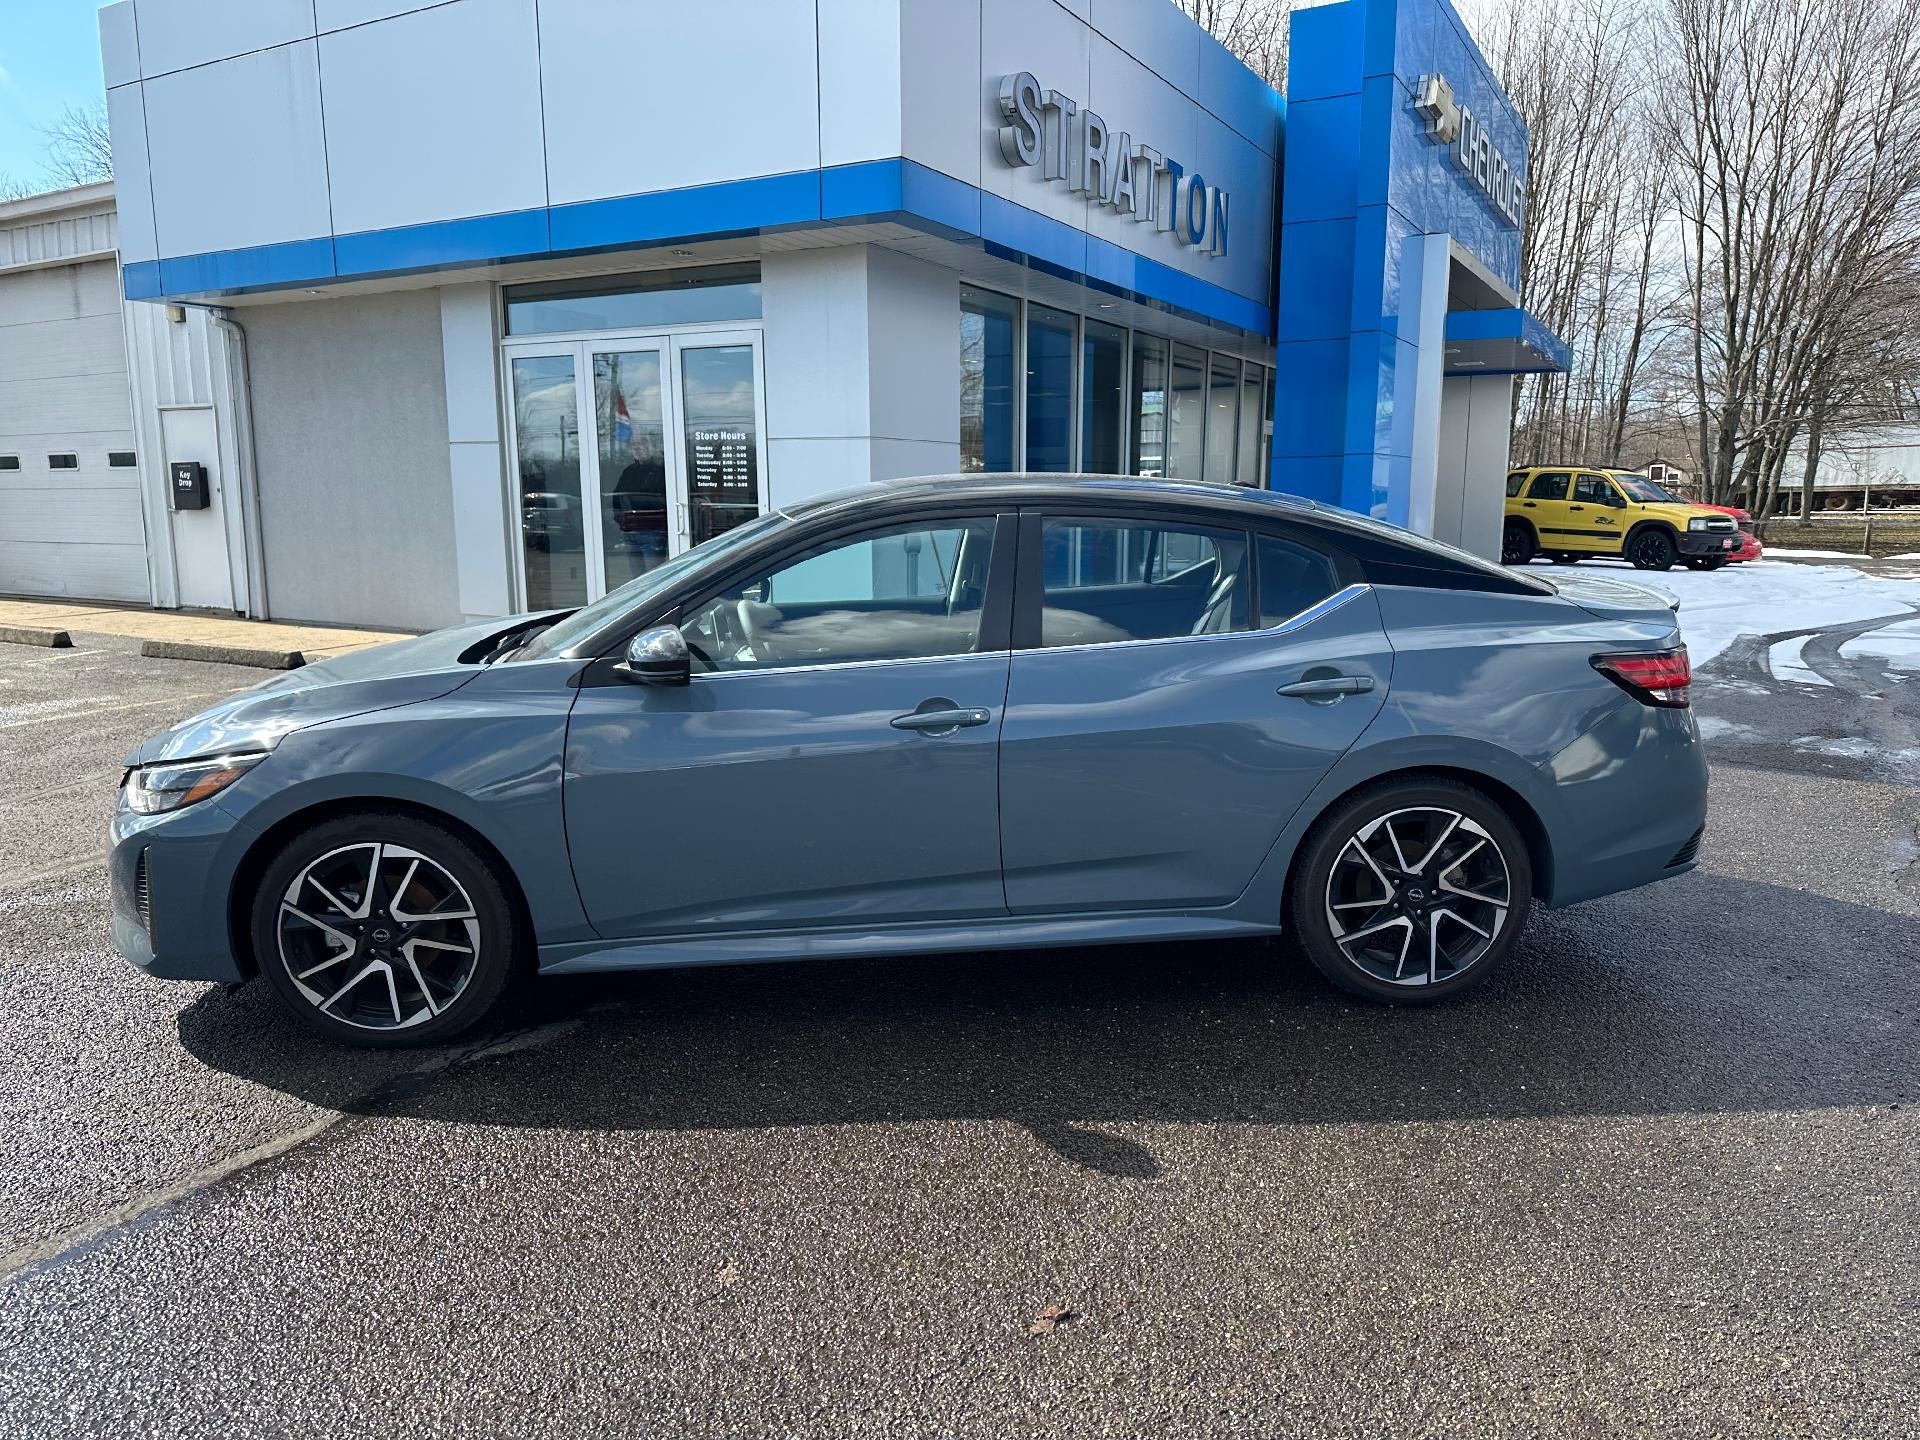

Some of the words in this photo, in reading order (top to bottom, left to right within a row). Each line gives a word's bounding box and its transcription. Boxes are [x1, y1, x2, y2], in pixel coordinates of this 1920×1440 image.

[999, 71, 1229, 257] STRATTON
[1458, 104, 1527, 231] CHEVROLET
[695, 431, 719, 441] Store
[720, 431, 746, 441] Hours
[179, 470, 191, 480] Key
[178, 479, 192, 488] Drop
